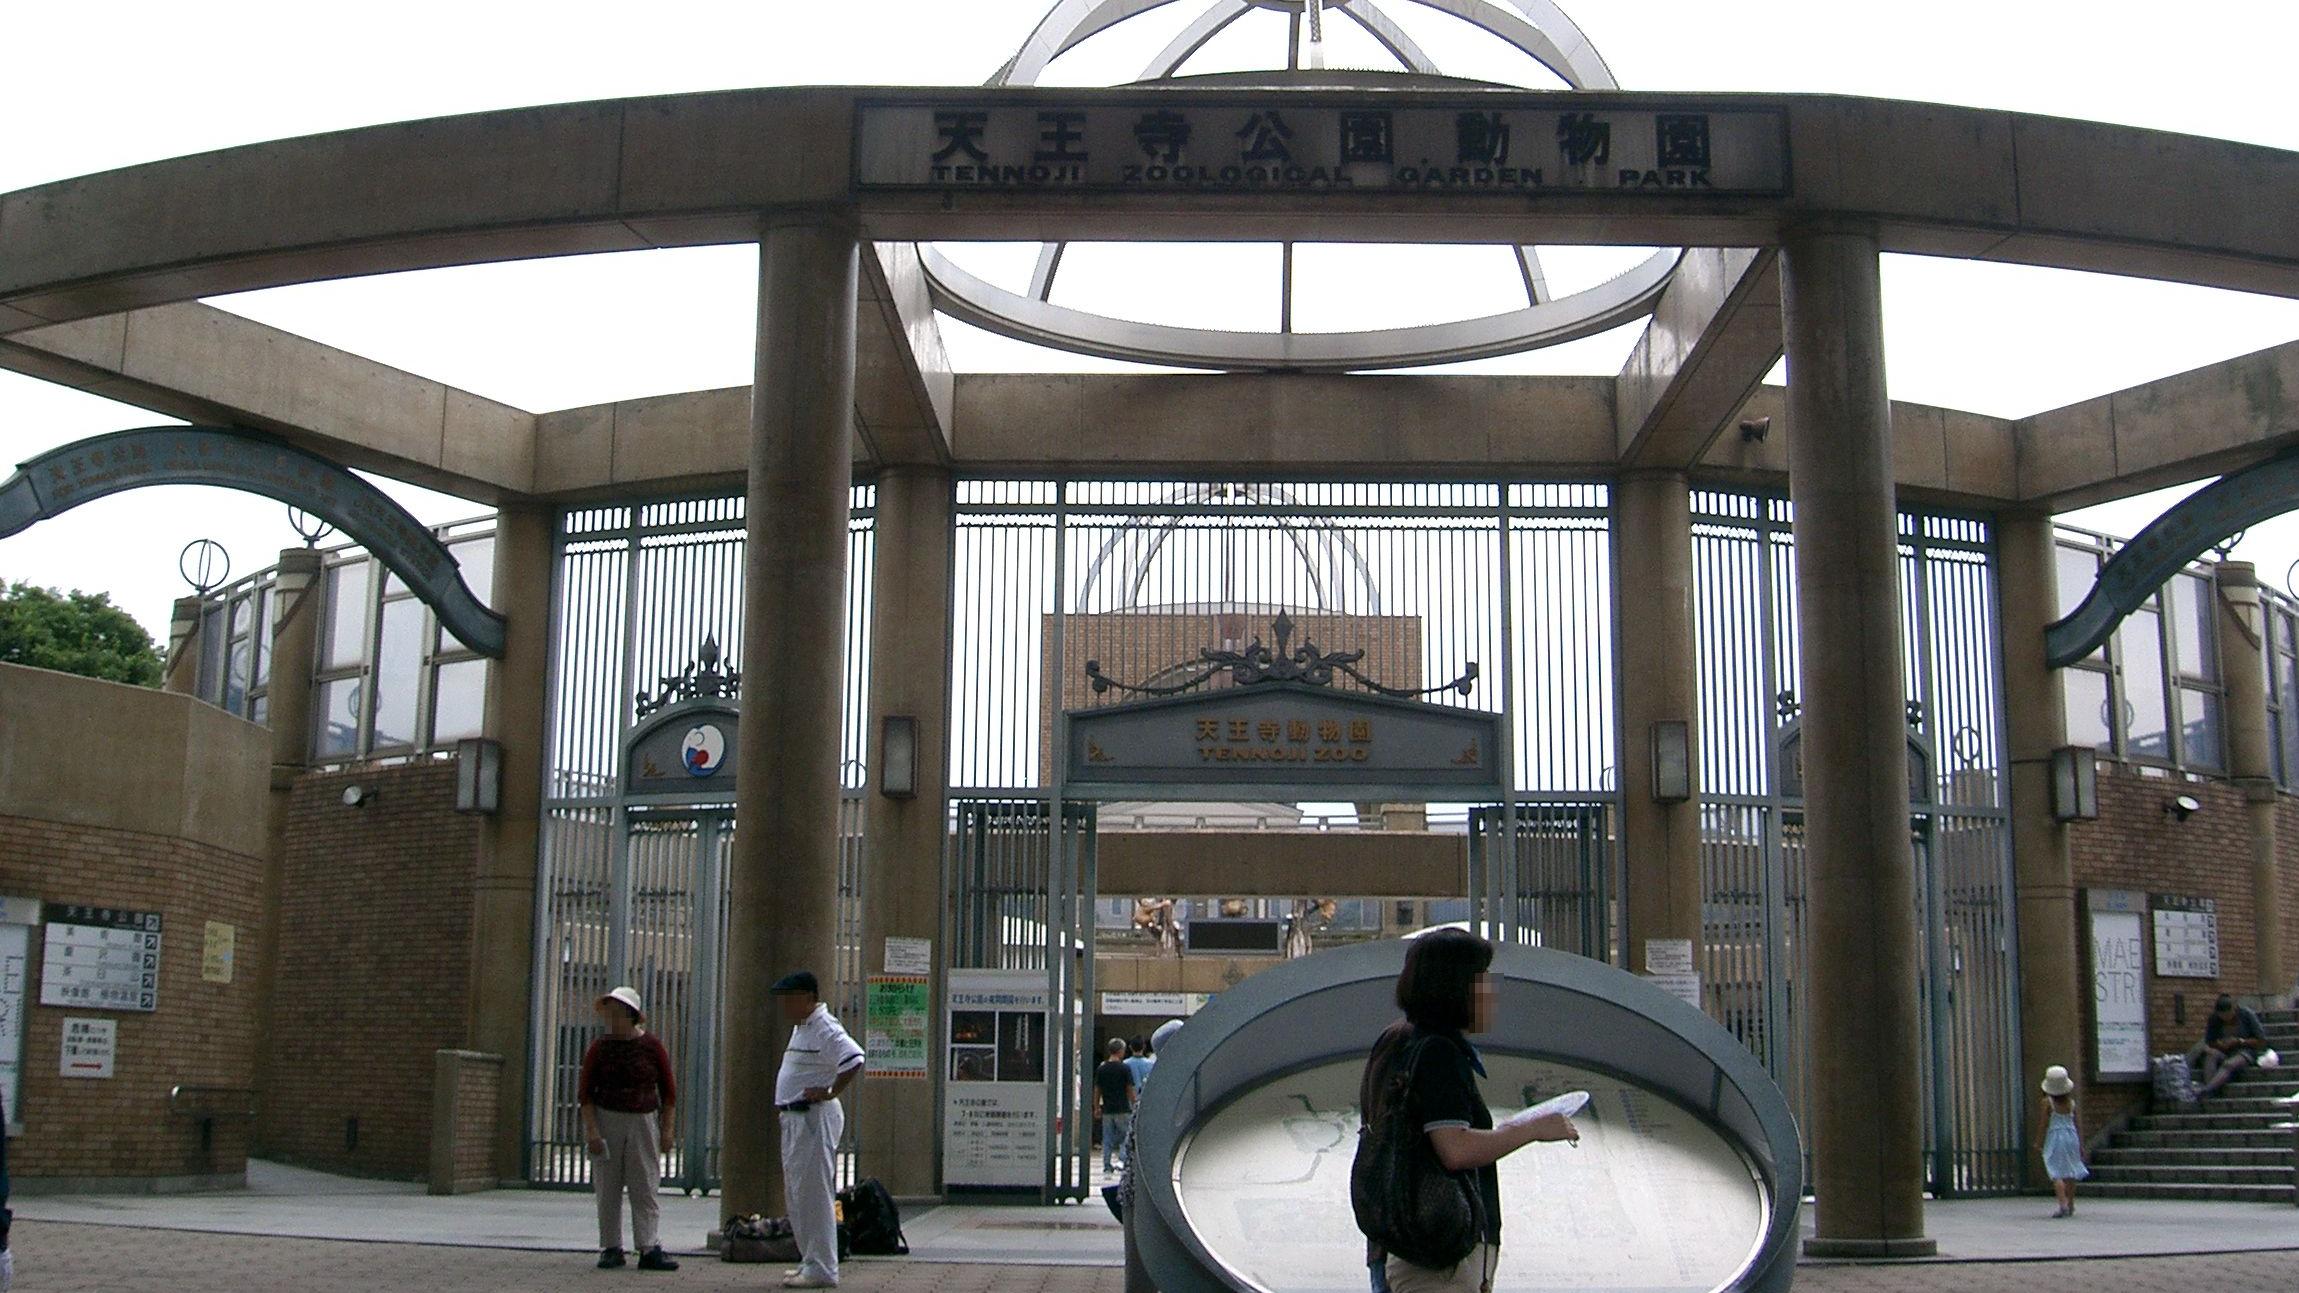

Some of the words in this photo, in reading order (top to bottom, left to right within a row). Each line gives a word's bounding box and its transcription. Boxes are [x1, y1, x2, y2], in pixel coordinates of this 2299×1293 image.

[932, 110, 1711, 167] 天王寺公園動物園
[931, 166, 1081, 182] TENNOJI
[1122, 166, 1353, 184] ZOOLOGICAL
[1396, 167, 1544, 185] GARDEN
[1619, 169, 1712, 187] PARK
[1195, 718, 1373, 742] 天王寺動物園
[1199, 747, 1308, 762] TENNOJI
[1314, 747, 1370, 762] ZOO
